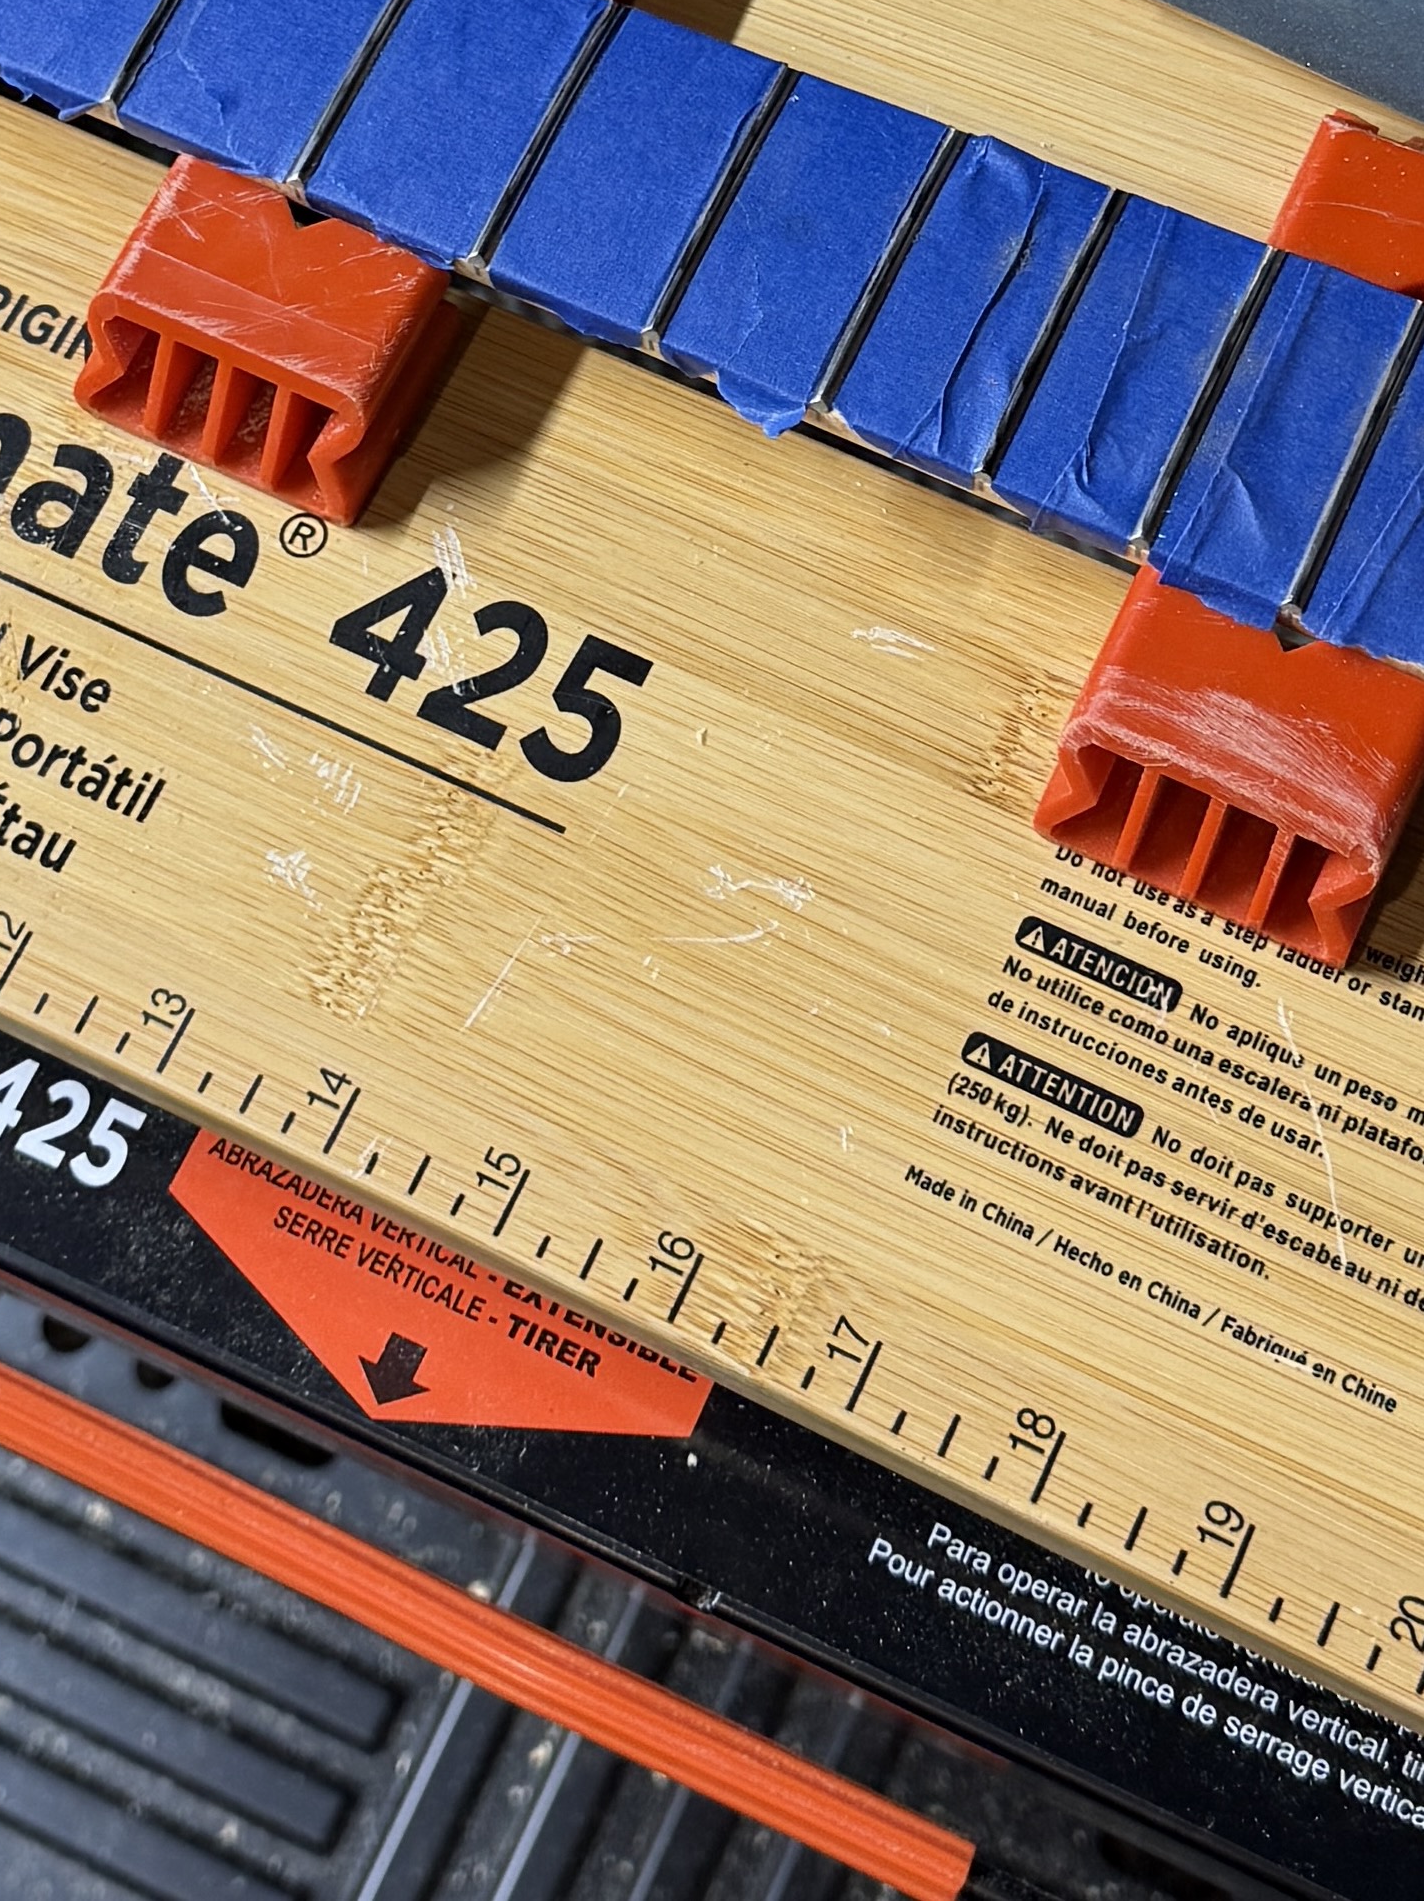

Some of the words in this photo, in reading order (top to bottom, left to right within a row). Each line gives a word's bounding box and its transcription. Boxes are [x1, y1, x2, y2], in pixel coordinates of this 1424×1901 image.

[16, 633, 112, 713] Vise
[328, 565, 654, 783] 425
[1039, 877, 1118, 921] manual
[1122, 909, 1190, 954] before
[1197, 947, 1261, 989] using.
[1221, 918, 1272, 953] step
[1346, 976, 1373, 997] or
[987, 989, 1014, 1013] de
[1016, 1000, 1169, 1085] instrucciones
[1170, 1076, 1234, 1115] antes
[1237, 1103, 1266, 1129] de
[1269, 1120, 1324, 1159] usar.
[1001, 954, 1033, 983] No
[1035, 974, 1105, 1016] utilice
[1107, 1008, 1170, 1046] como
[1171, 1036, 1215, 1067] una
[1217, 1057, 1312, 1112] escalera
[1316, 1102, 1343, 1124] ni
[1188, 1002, 1220, 1031] No
[1225, 1024, 1306, 1069] aplique
[1313, 1063, 1343, 1087] un
[1342, 1077, 1399, 1112] peso
[931, 1103, 1069, 1182] instructions
[1069, 1173, 1138, 1214] avant
[1134, 1198, 1270, 1280] l'utilisation.
[946, 1071, 994, 1106] (250
[992, 1091, 1032, 1128] kg).
[1043, 1115, 1075, 1144] Ne
[1078, 1134, 1124, 1168] doit
[1122, 1158, 1167, 1188] pas
[1169, 1179, 1239, 1220] servir
[1240, 1210, 1373, 1285] d'escabeau
[1375, 1276, 1402, 1298] ni
[997, 1053, 1136, 1132] ATTENTION
[1150, 1124, 1182, 1154] No
[1189, 1145, 1234, 1179] doit
[1233, 1169, 1277, 1198] pas
[1284, 1192, 1396, 1253] supporter
[141, 987, 187, 1030] 13
[475, 1146, 522, 1191] 15
[1196, 1500, 1245, 1548] 19
[273, 1206, 353, 1258] SERRE
[357, 1241, 487, 1322] VERTICALE
[508, 1313, 601, 1377] TIRER
[903, 1164, 956, 1202] Made
[958, 1188, 978, 1213] in
[981, 1201, 1035, 1241] China
[1052, 1234, 1114, 1277] Hecho
[1117, 1269, 1143, 1292] en
[1146, 1280, 1202, 1320] China
[1219, 1314, 1309, 1366] Fabriqué
[1311, 1362, 1337, 1385] en
[1340, 1372, 1398, 1413] Chine
[867, 1536, 935, 1588] Pour
[936, 1577, 1066, 1651] actionner
[1067, 1633, 1094, 1668] la
[1096, 1654, 1175, 1705] pince
[1180, 1692, 1217, 1726] de
[1222, 1715, 1330, 1781] serrage
[928, 1521, 993, 1572] Para
[997, 1562, 1089, 1619] operar
[1091, 1600, 1118, 1635] la
[1123, 1619, 1279, 1713] abrazadera
[1288, 1700, 1392, 1770] vertical,
